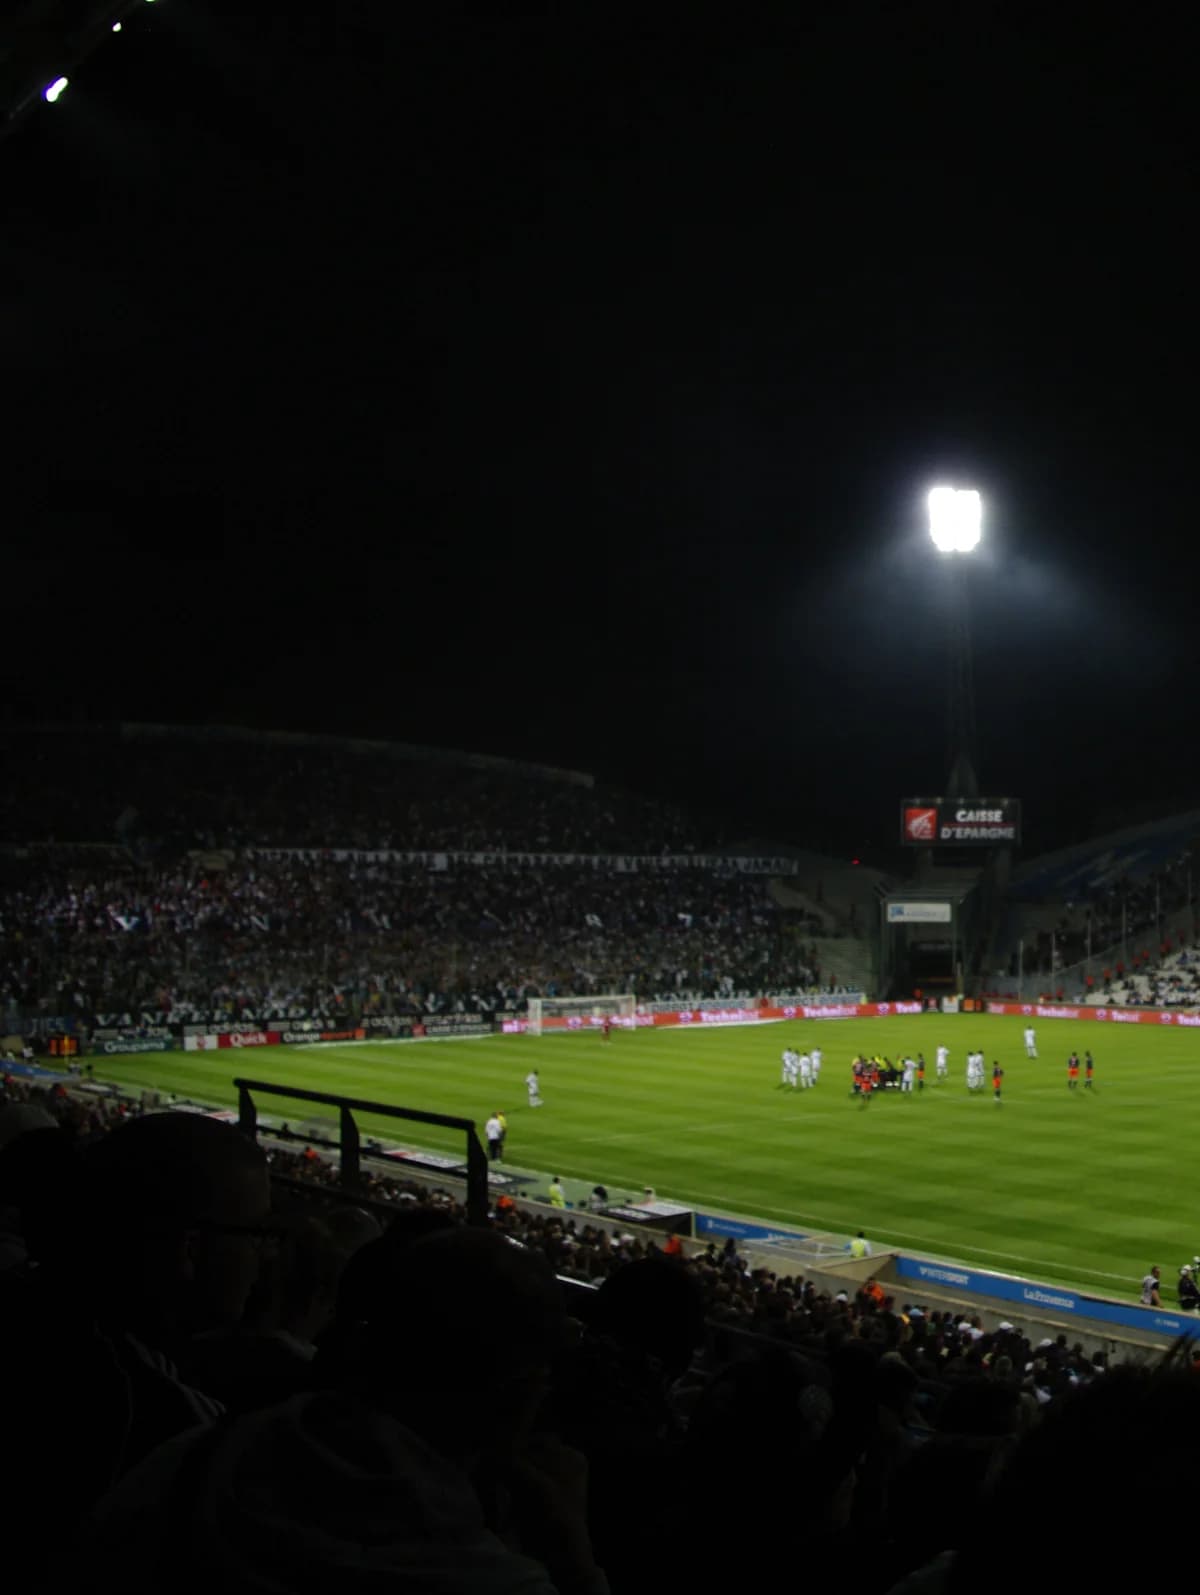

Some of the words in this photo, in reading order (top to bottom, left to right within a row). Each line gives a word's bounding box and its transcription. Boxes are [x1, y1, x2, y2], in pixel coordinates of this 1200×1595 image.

[955, 810, 1003, 823] CAISSE
[940, 826, 1015, 840] D'EPARGNE
[231, 1031, 267, 1047] Quick
[283, 1031, 320, 1044] Orange
[103, 1039, 166, 1054] Groupama
